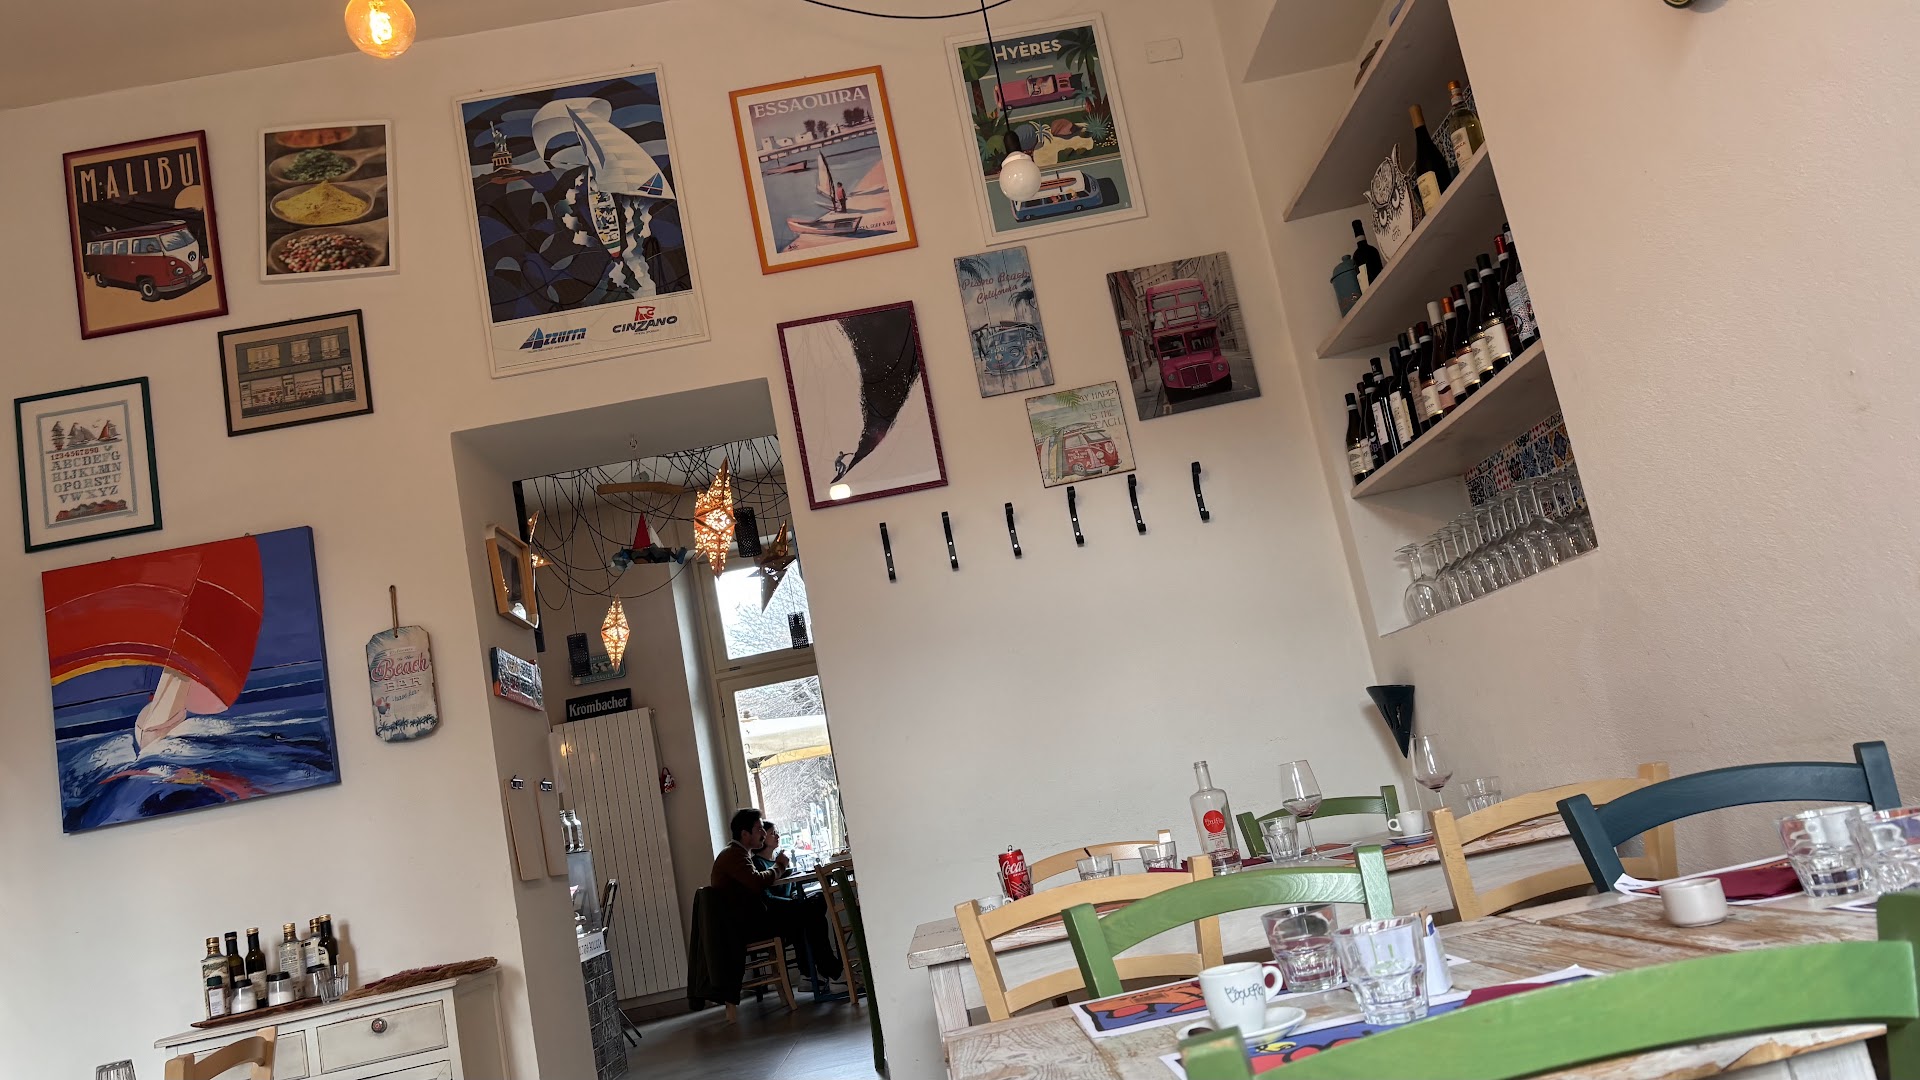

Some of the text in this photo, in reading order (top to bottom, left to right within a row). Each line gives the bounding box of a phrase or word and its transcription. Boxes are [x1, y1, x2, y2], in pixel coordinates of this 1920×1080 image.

[993, 39, 1062, 62] HYÈRES
[753, 87, 867, 118] ESSAOUIRA
[80, 152, 196, 203] MALIBU
[612, 315, 678, 333] CINZANO
[371, 652, 429, 683] Beach
[569, 696, 628, 718] Krombacher
